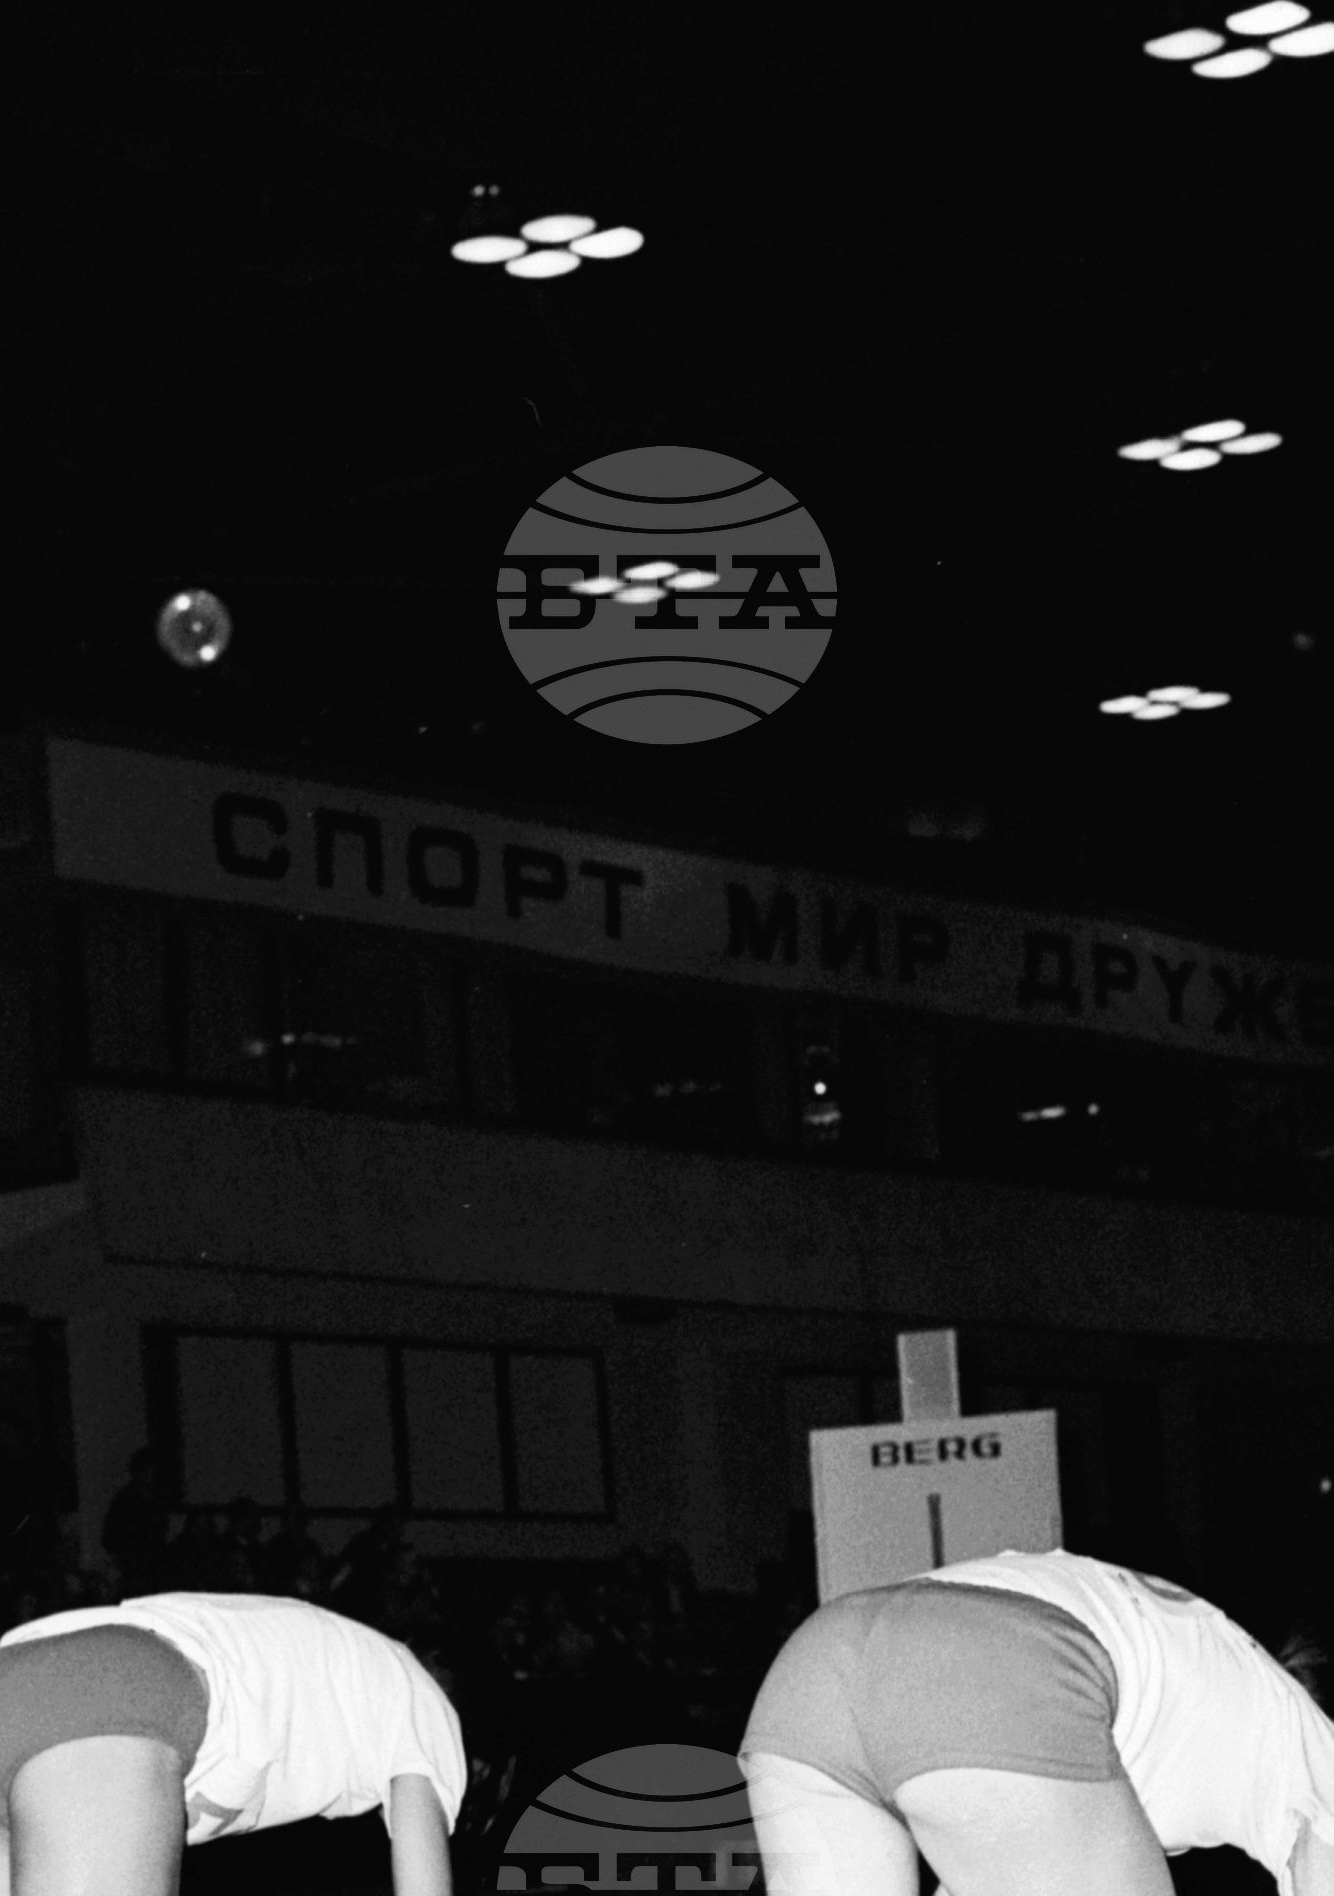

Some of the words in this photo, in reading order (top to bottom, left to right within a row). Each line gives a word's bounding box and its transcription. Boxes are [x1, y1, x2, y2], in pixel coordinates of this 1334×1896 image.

[212, 791, 646, 941] СПОРТ
[725, 881, 950, 984] МИР
[870, 1431, 1003, 1469] BERG
